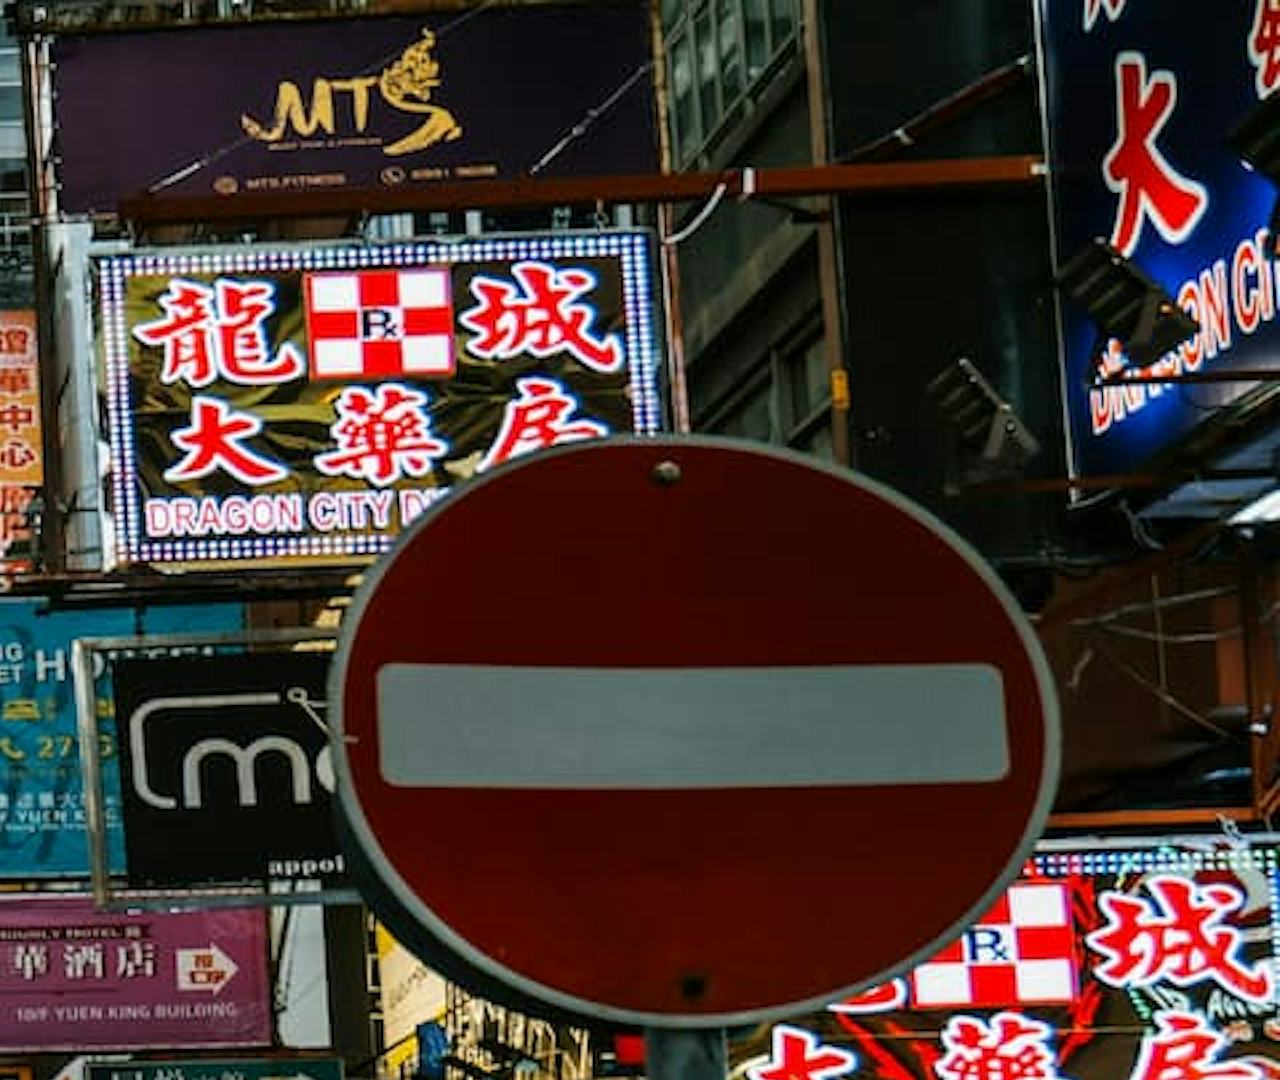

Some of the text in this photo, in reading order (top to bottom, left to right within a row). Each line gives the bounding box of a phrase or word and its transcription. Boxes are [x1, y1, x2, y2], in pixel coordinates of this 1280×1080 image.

[136, 278, 303, 389] 龍
[460, 261, 621, 371] 城
[145, 496, 303, 537] DRAGON
[309, 491, 391, 531] CITY
[1085, 876, 1276, 999] 城
[154, 1001, 237, 1019] BUILDING
